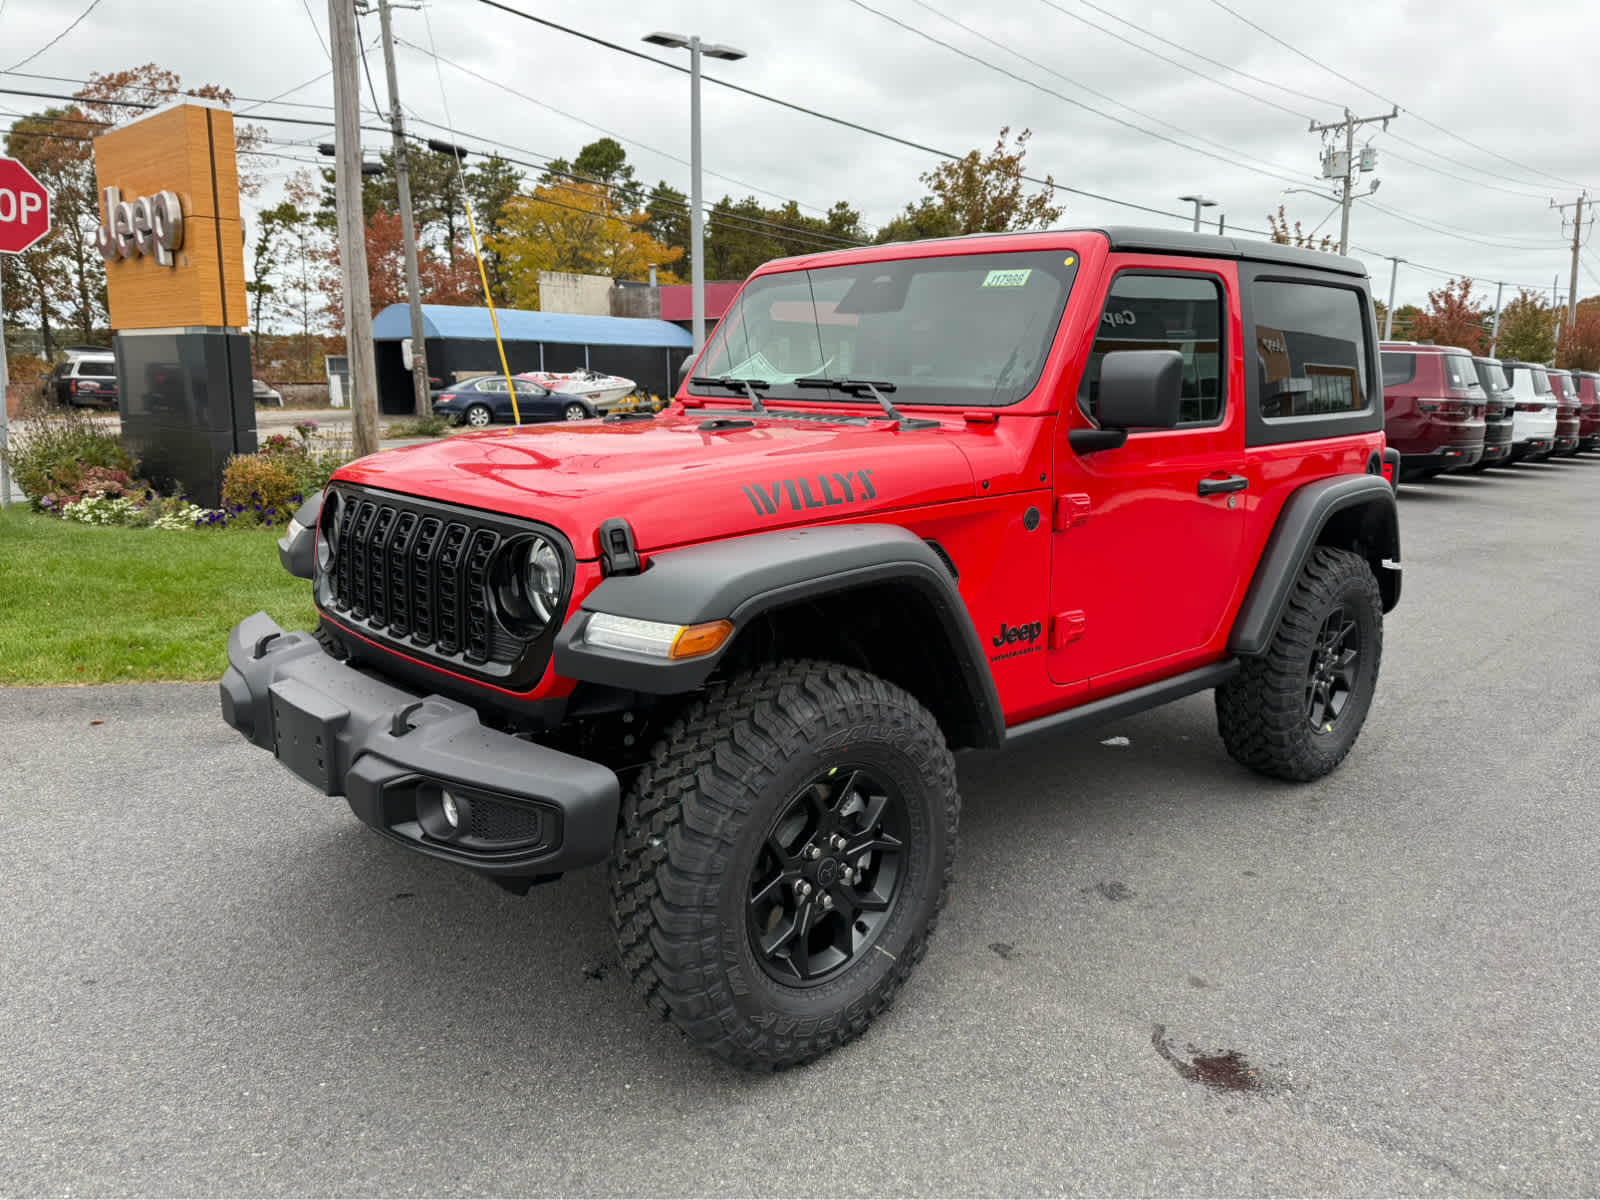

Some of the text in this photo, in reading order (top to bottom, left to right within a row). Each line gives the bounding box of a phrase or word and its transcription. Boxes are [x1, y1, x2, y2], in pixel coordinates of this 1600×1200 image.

[96, 186, 184, 267] Jeep
[741, 469, 876, 516] WILLYS
[992, 621, 1042, 648] Jeep
